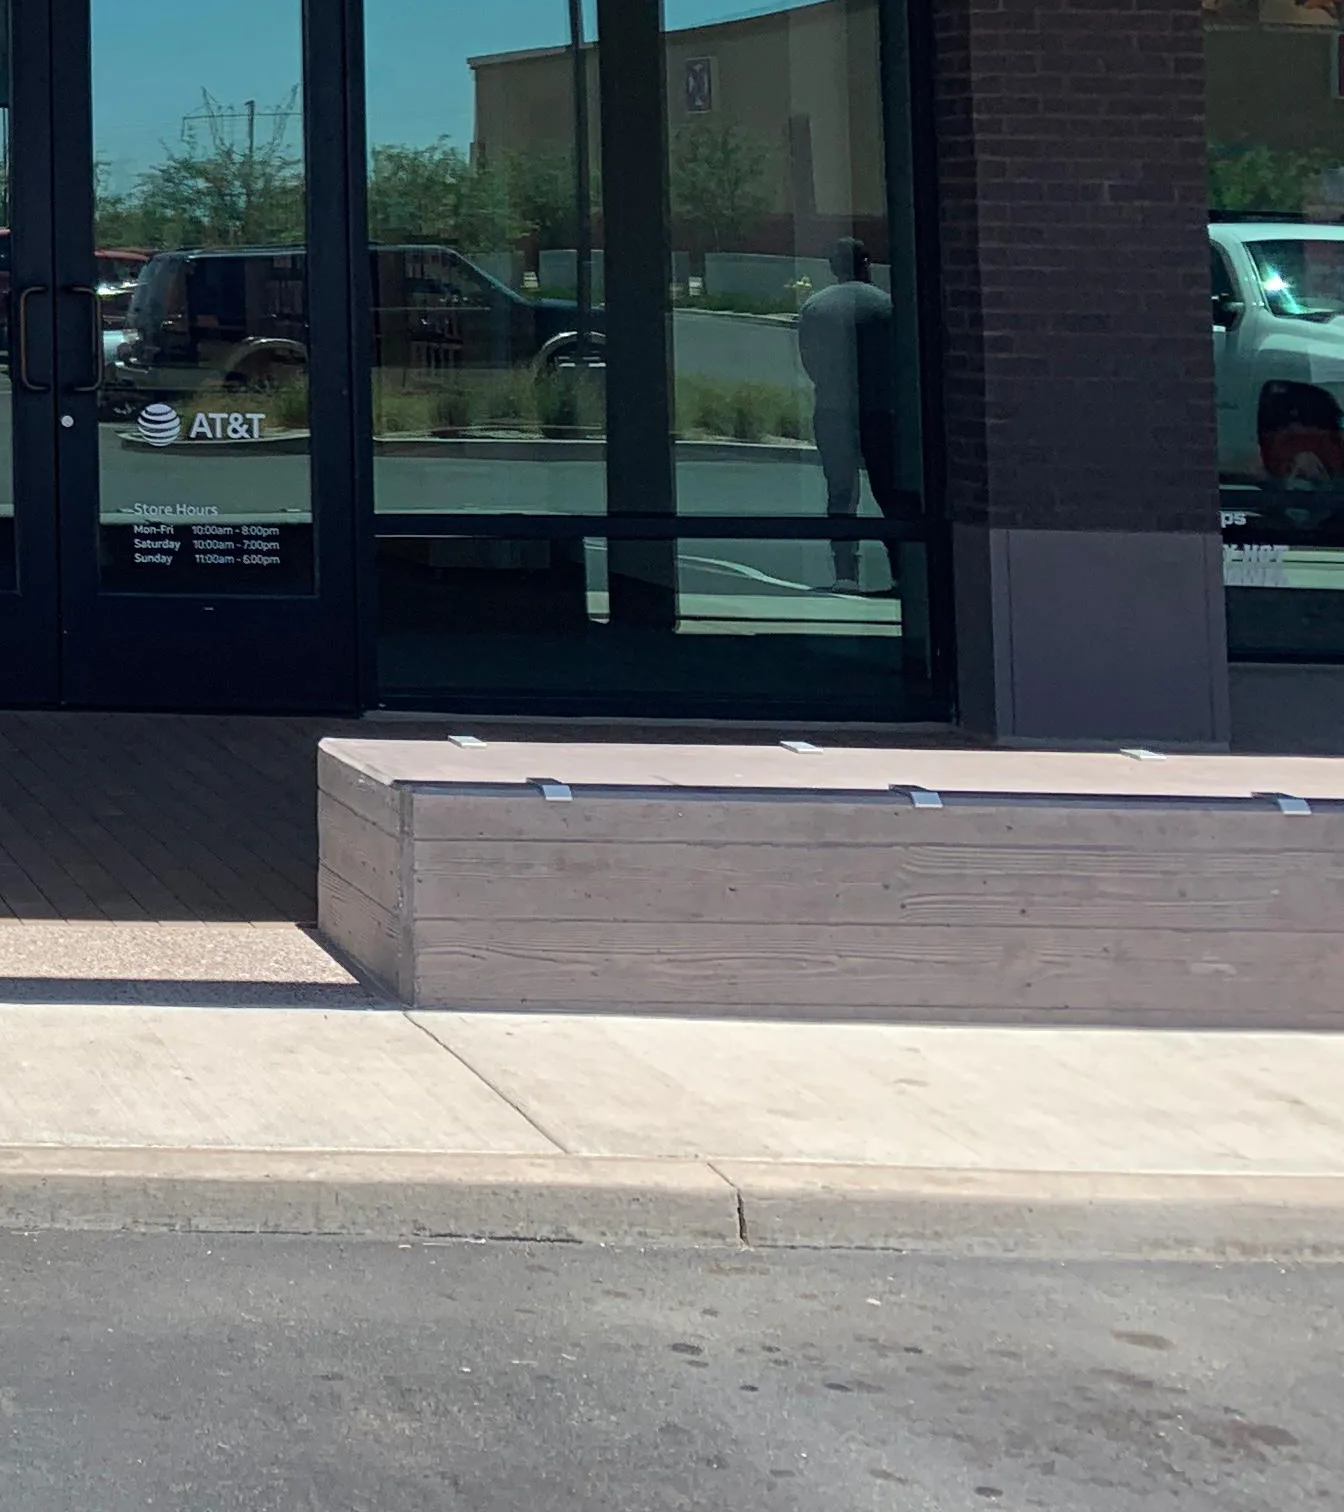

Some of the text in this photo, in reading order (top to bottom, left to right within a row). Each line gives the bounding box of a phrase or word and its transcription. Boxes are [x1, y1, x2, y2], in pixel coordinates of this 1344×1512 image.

[189, 412, 266, 439] AT&T
[133, 503, 219, 517] Store Hours
[133, 525, 175, 535] Mon-Fri
[191, 525, 234, 536] 10:00am
[133, 539, 181, 551] Saturday
[192, 540, 235, 550] 10:00am
[133, 553, 174, 565] Sunday
